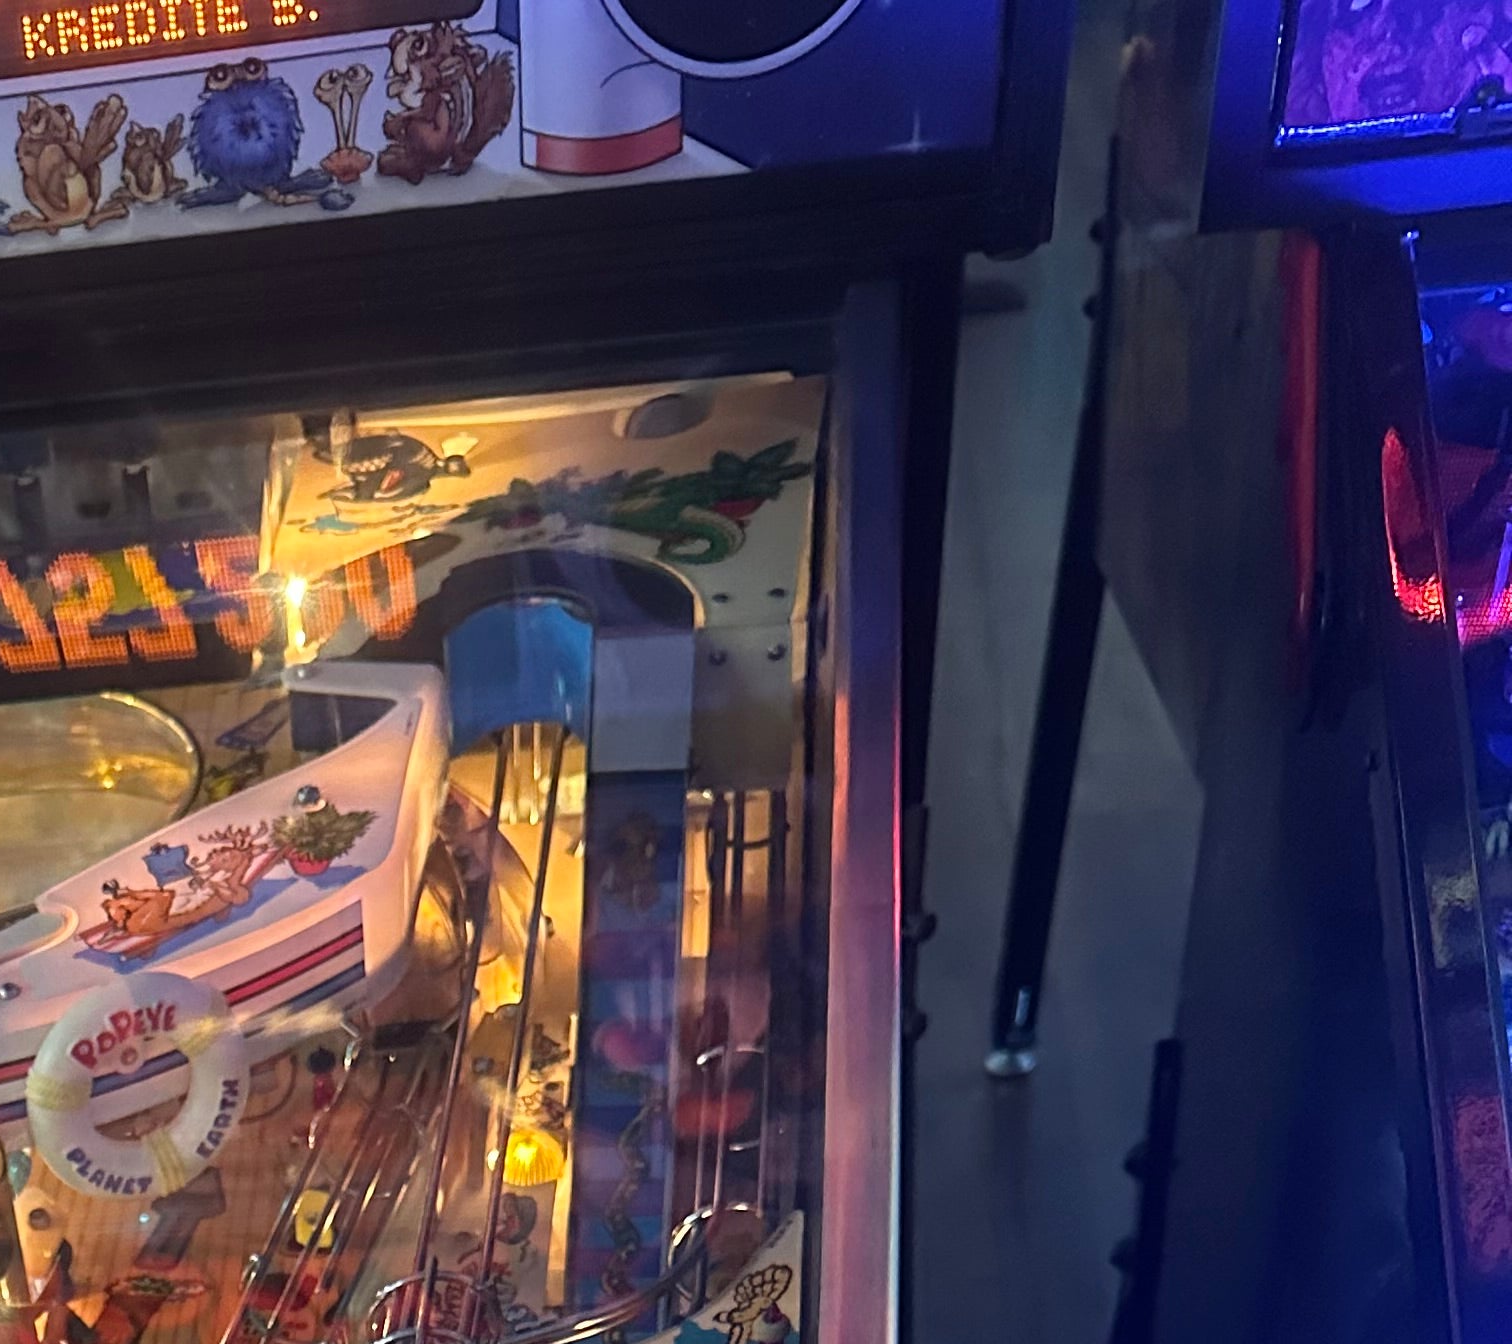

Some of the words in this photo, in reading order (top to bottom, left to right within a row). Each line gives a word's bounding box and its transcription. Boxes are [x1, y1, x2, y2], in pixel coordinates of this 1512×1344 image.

[71, 1000, 176, 1069] POPEYE
[196, 1079, 240, 1159] EARTH
[66, 1147, 153, 1195] PLANET
